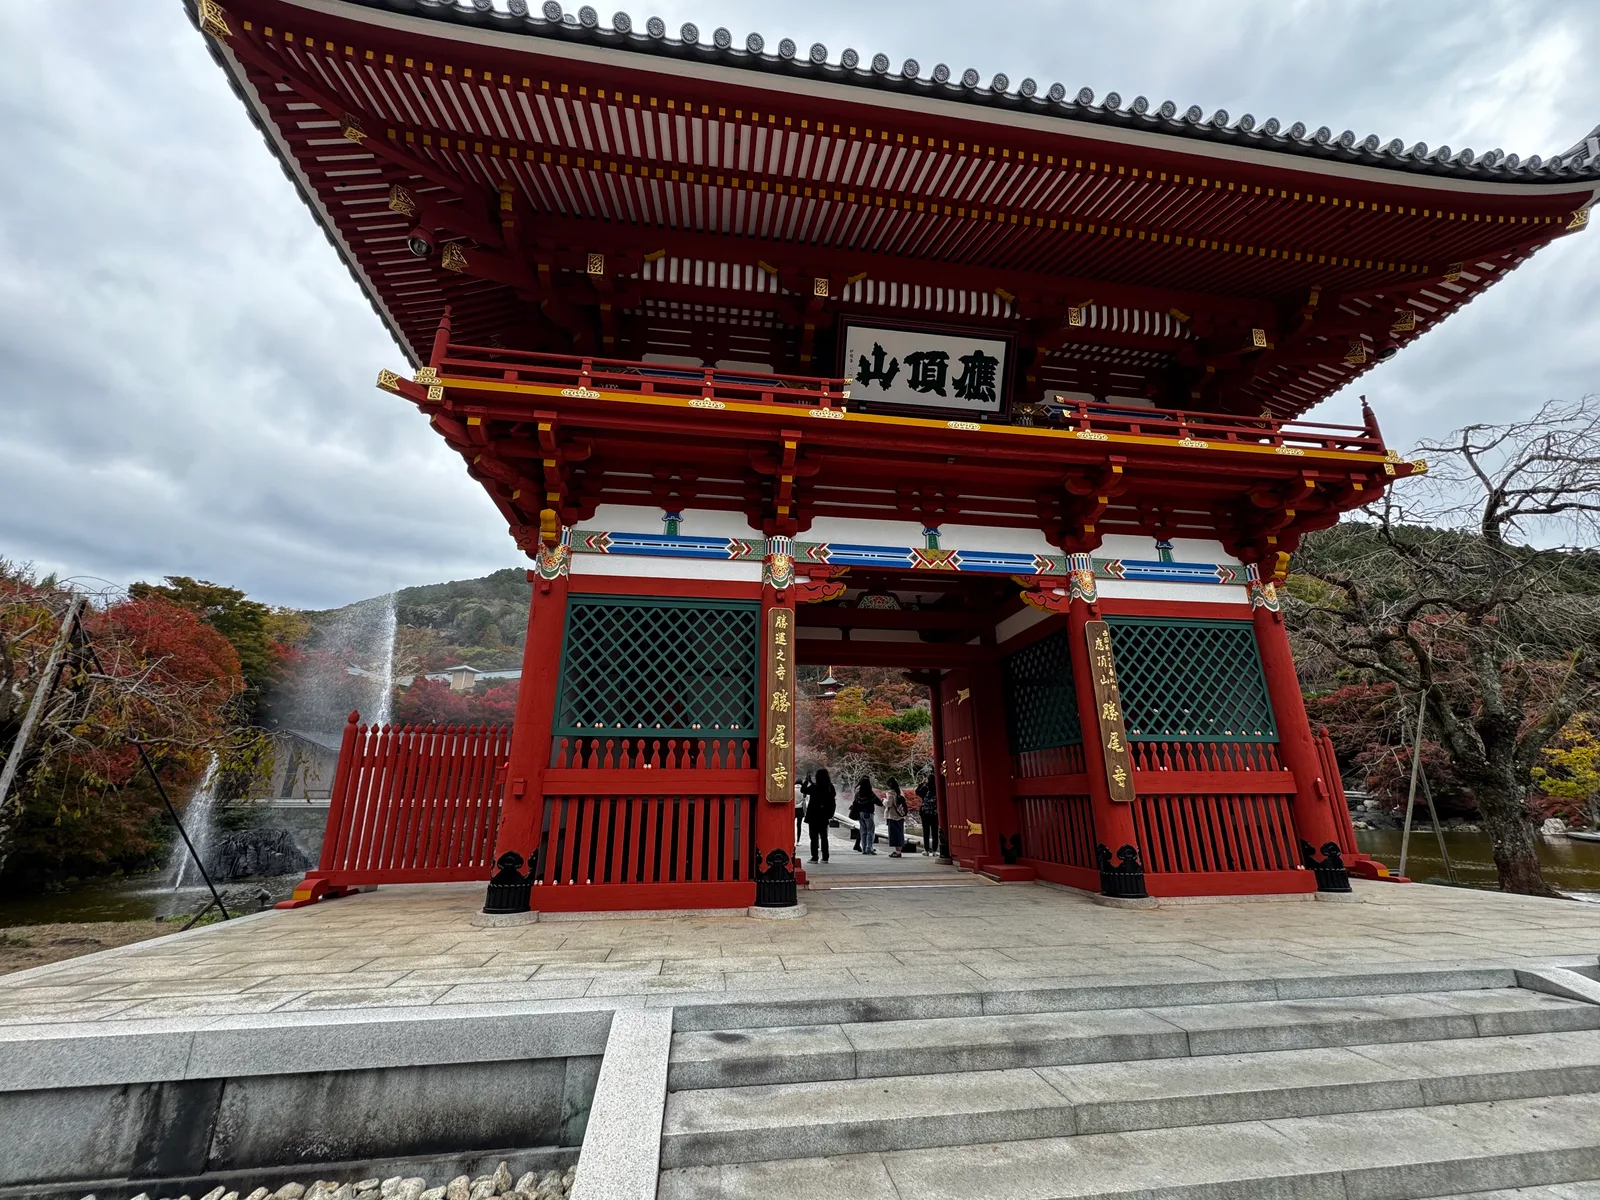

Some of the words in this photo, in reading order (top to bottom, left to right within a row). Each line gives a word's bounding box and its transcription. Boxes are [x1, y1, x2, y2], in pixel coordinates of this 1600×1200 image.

[770, 689, 791, 789] 勝尾寺
[1102, 701, 1127, 788] 勝尾寺
